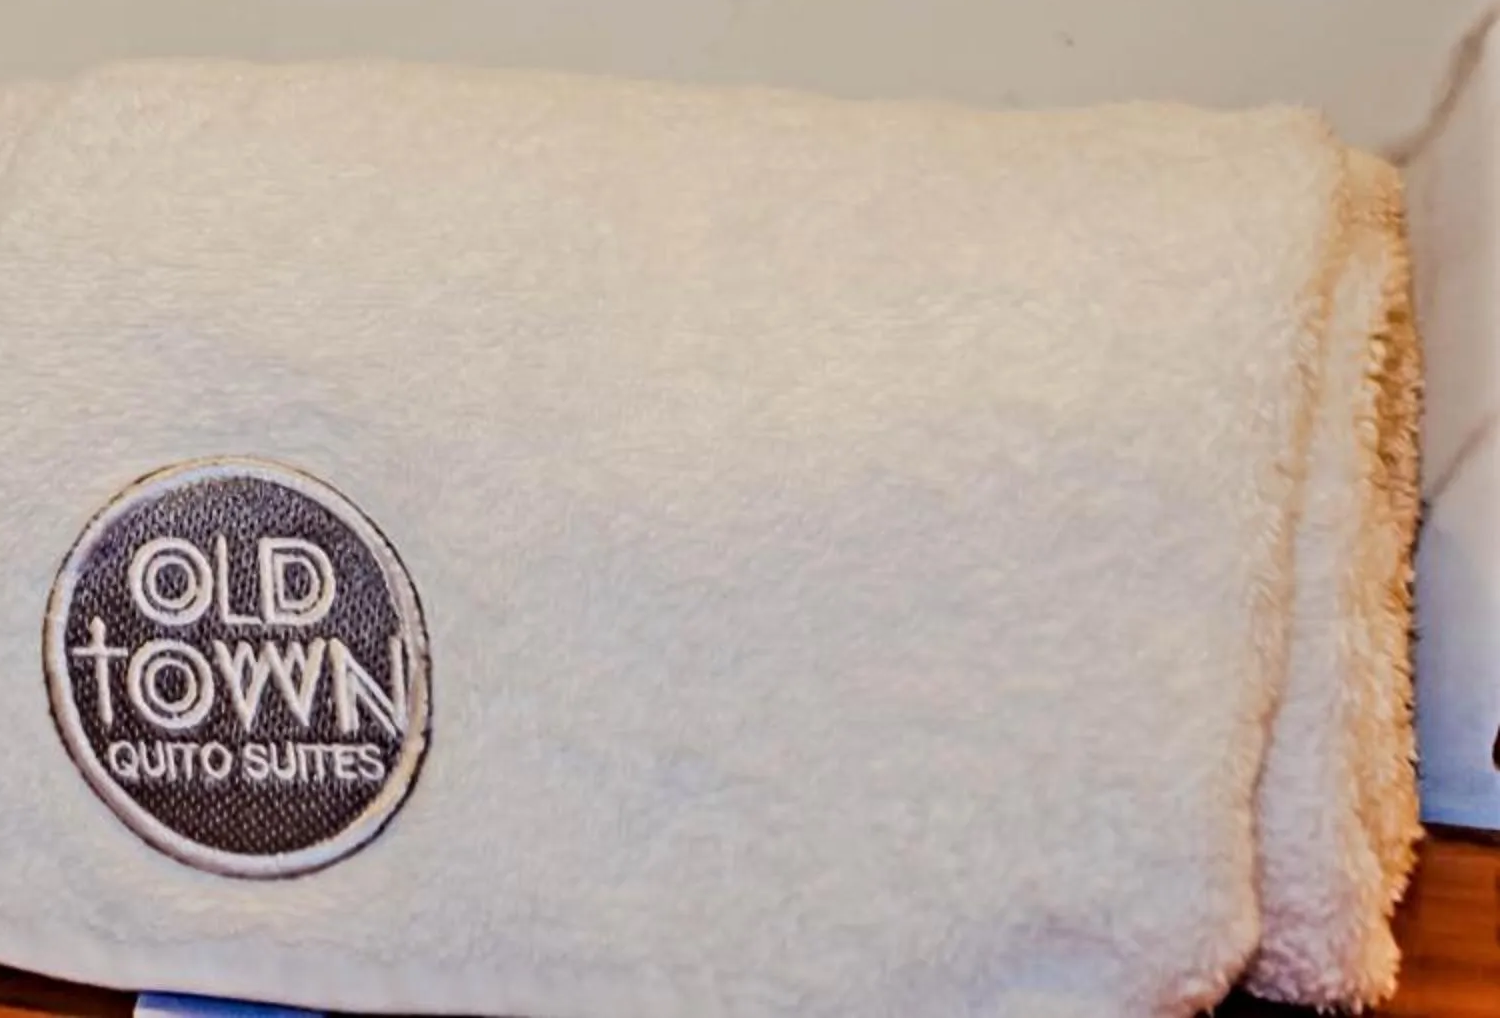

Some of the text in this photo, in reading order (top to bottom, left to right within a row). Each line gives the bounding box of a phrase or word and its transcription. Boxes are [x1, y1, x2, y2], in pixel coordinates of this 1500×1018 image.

[128, 534, 337, 627] OLD
[108, 741, 387, 783] QUITO SUITES
